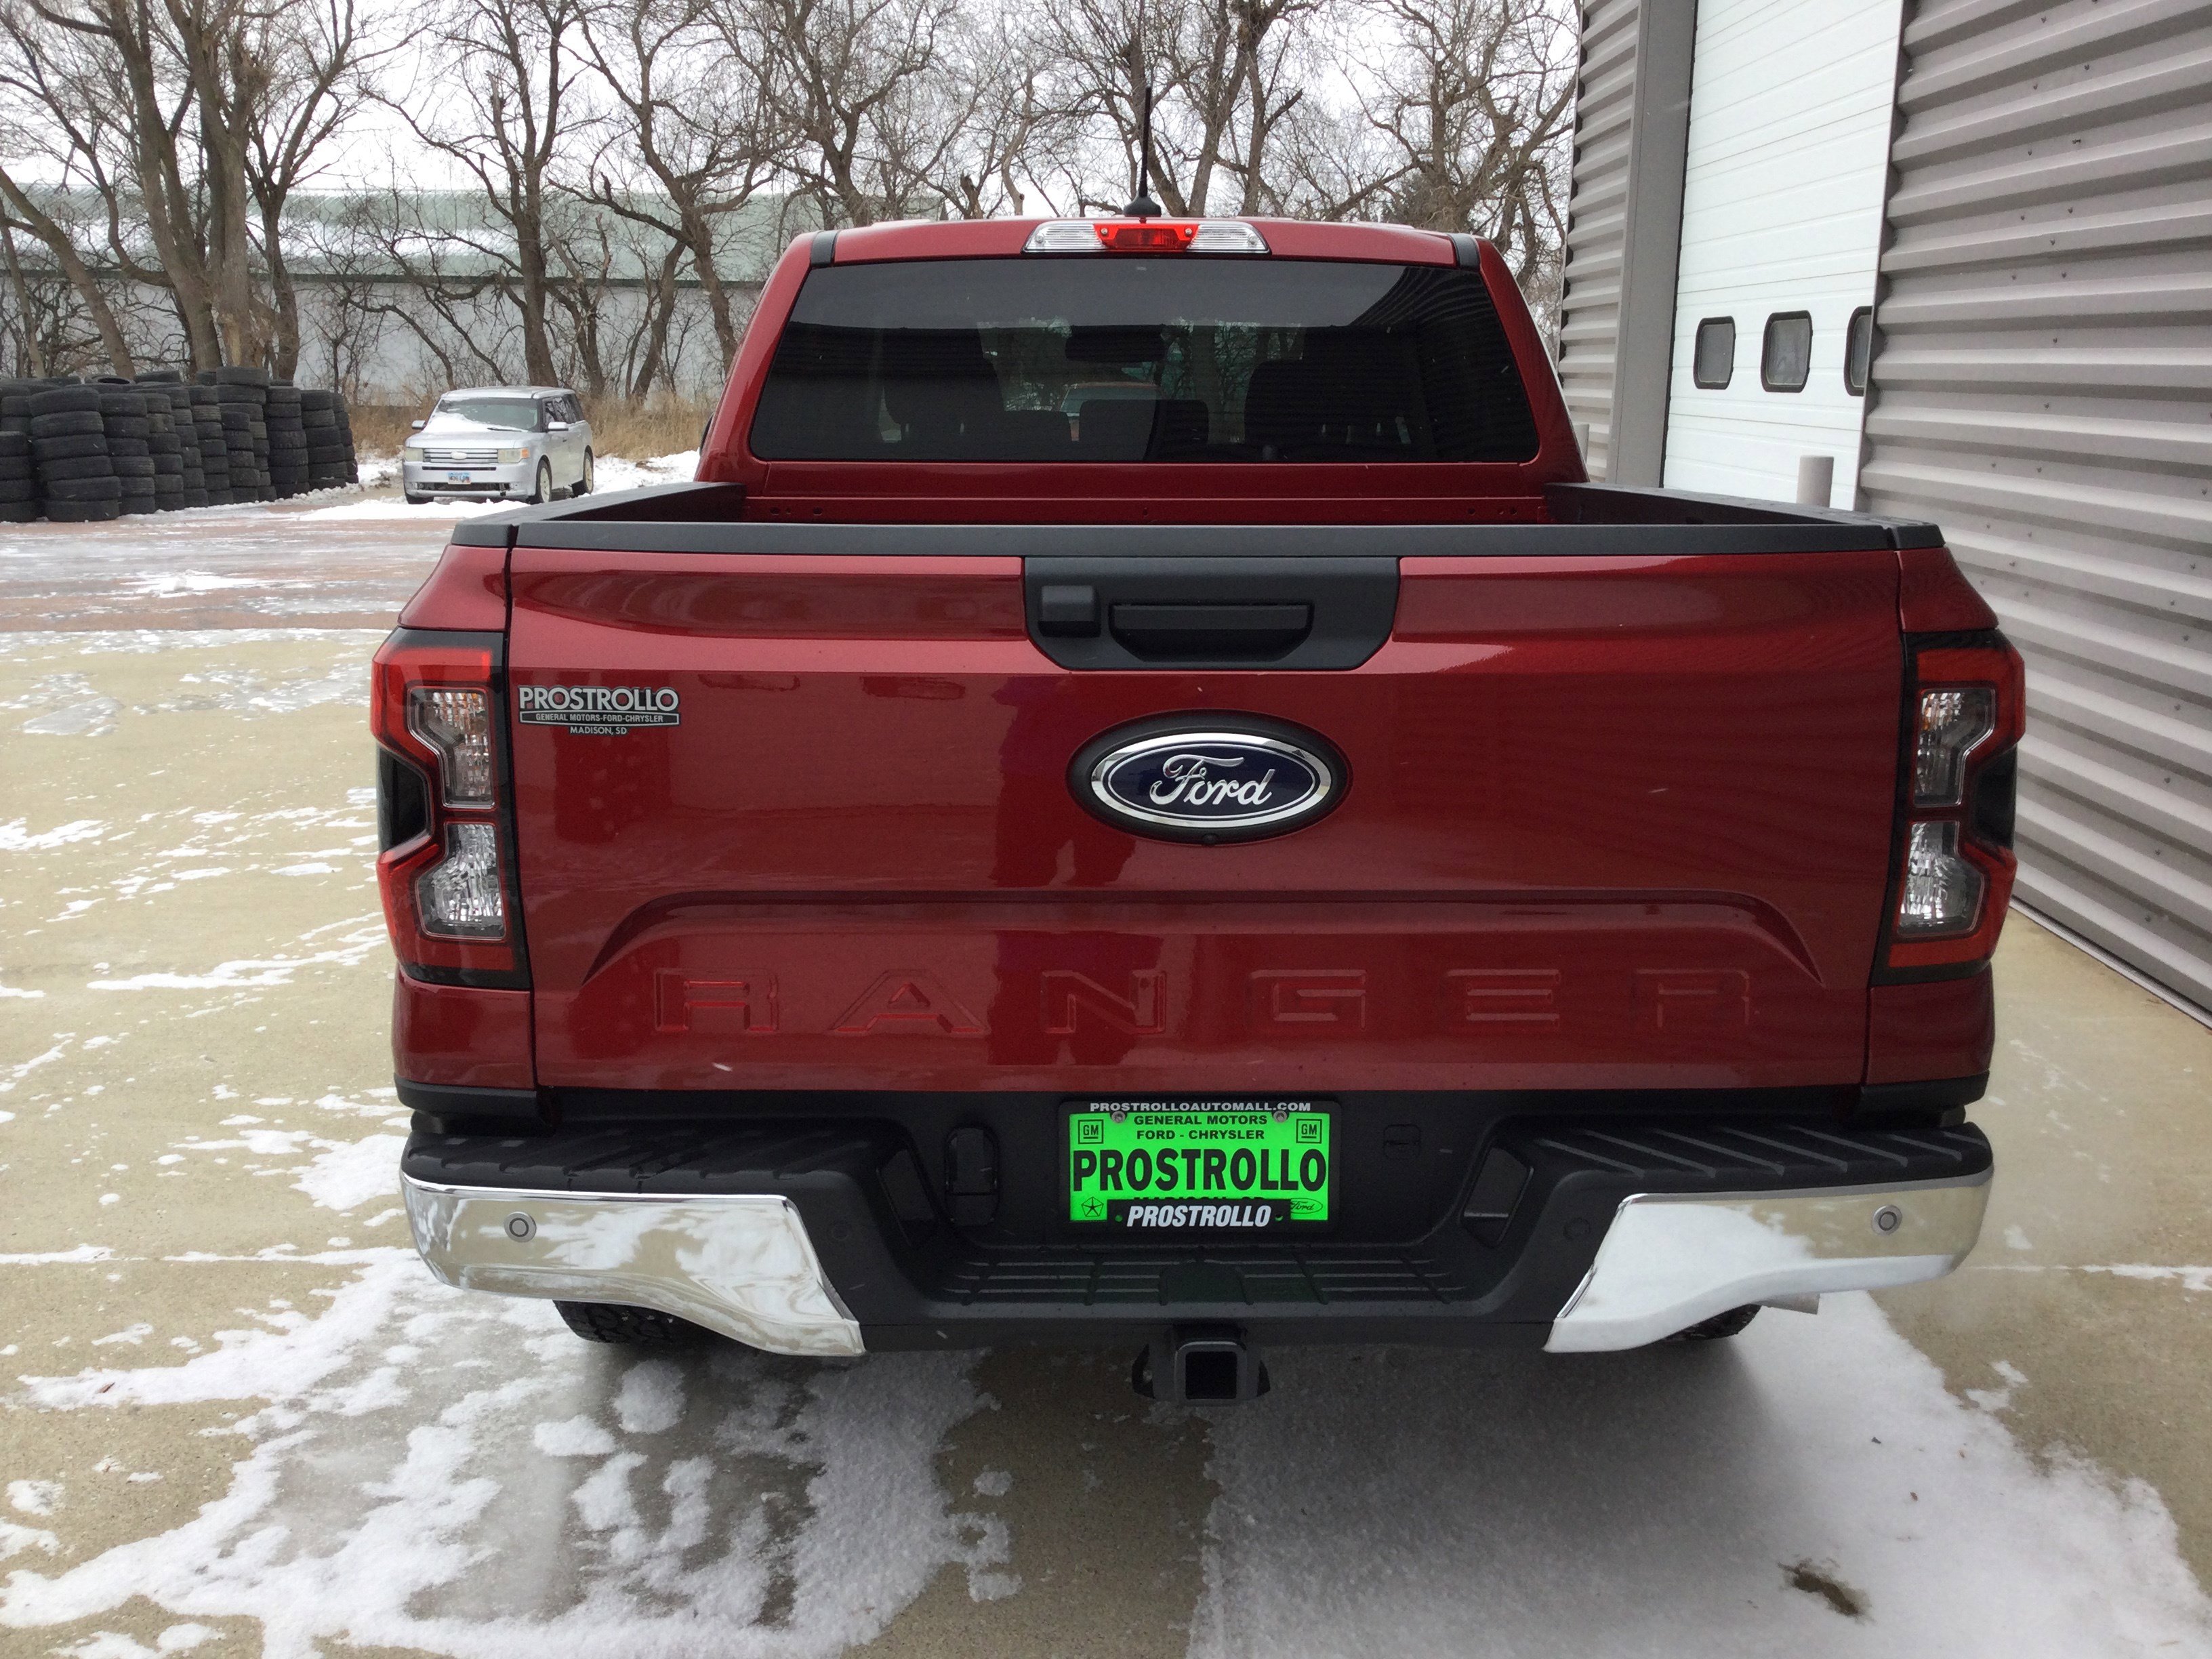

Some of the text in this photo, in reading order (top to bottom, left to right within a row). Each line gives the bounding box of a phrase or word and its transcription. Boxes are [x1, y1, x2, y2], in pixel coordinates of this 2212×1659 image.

[519, 687, 678, 711] PROSTROLLO
[570, 726, 613, 735] MADISON,
[1149, 754, 1275, 805] Ford
[654, 967, 1751, 1036] RANGER
[1090, 1102, 1311, 1112] PROSTROLLOAUTOMALL.COM
[1134, 1115, 1267, 1125] GENERAL MOTORS
[1083, 1125, 1099, 1136] GM
[1136, 1130, 1176, 1140] FORD
[1189, 1130, 1265, 1140] CHRYSLER
[1300, 1124, 1317, 1135] GM
[1073, 1148, 1326, 1191] PROSTROLLO
[1126, 1205, 1271, 1227] PROSTROLLO
